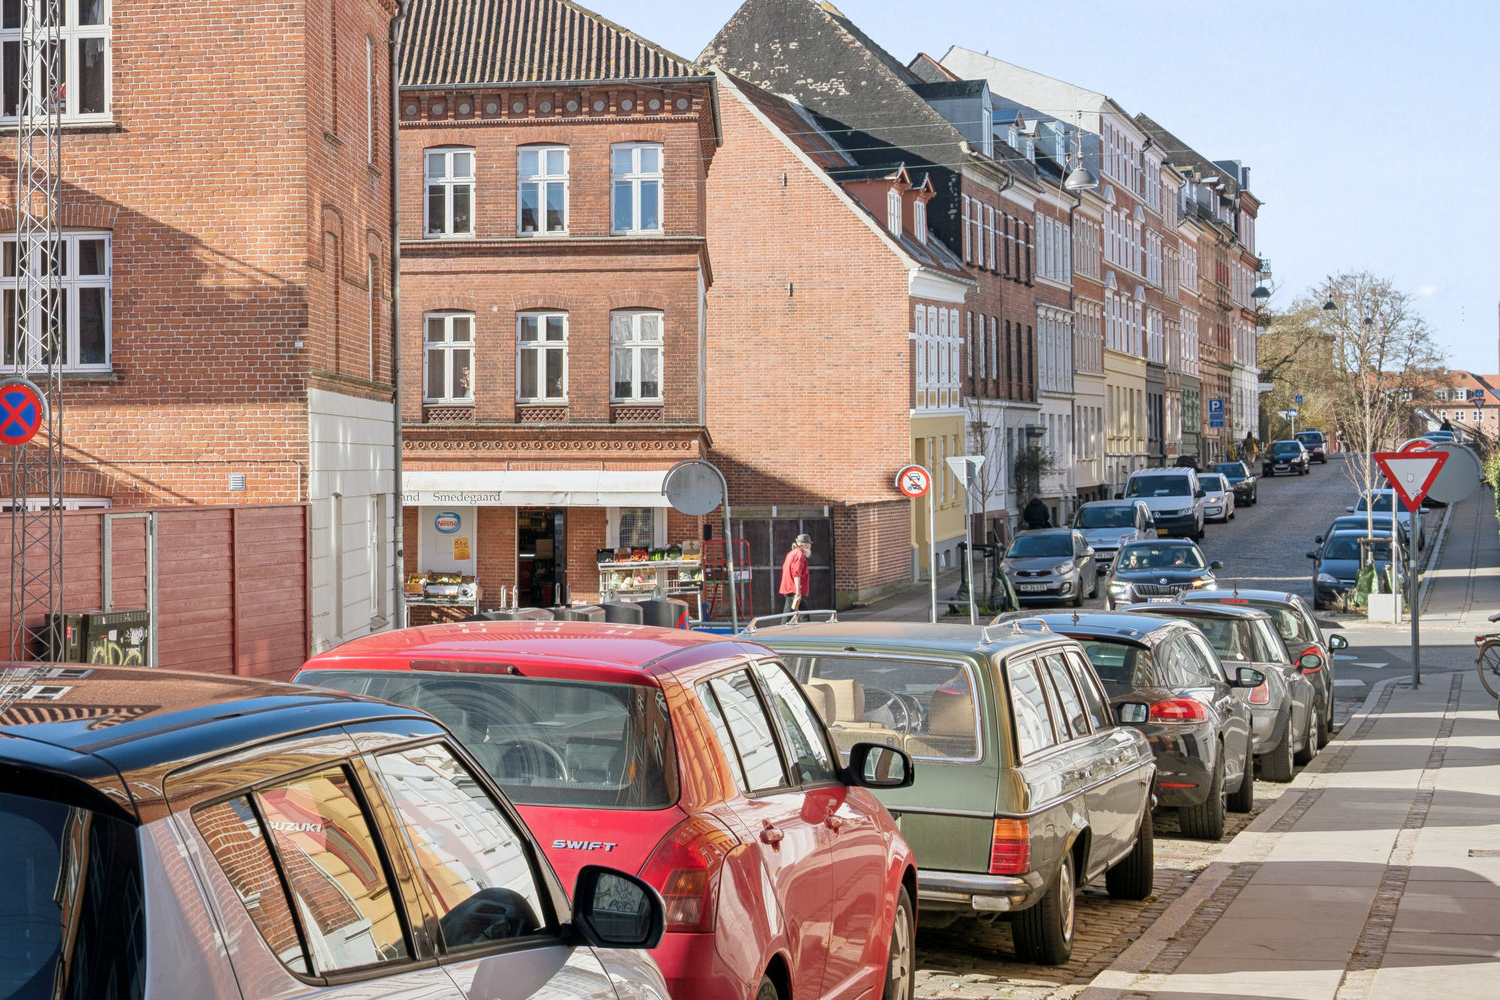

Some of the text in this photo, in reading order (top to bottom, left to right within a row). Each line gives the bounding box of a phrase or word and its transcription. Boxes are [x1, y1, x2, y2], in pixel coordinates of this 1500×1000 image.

[1211, 401, 1220, 411] P
[433, 491, 500, 504] Smedegaard
[552, 839, 616, 852] SWIFT
